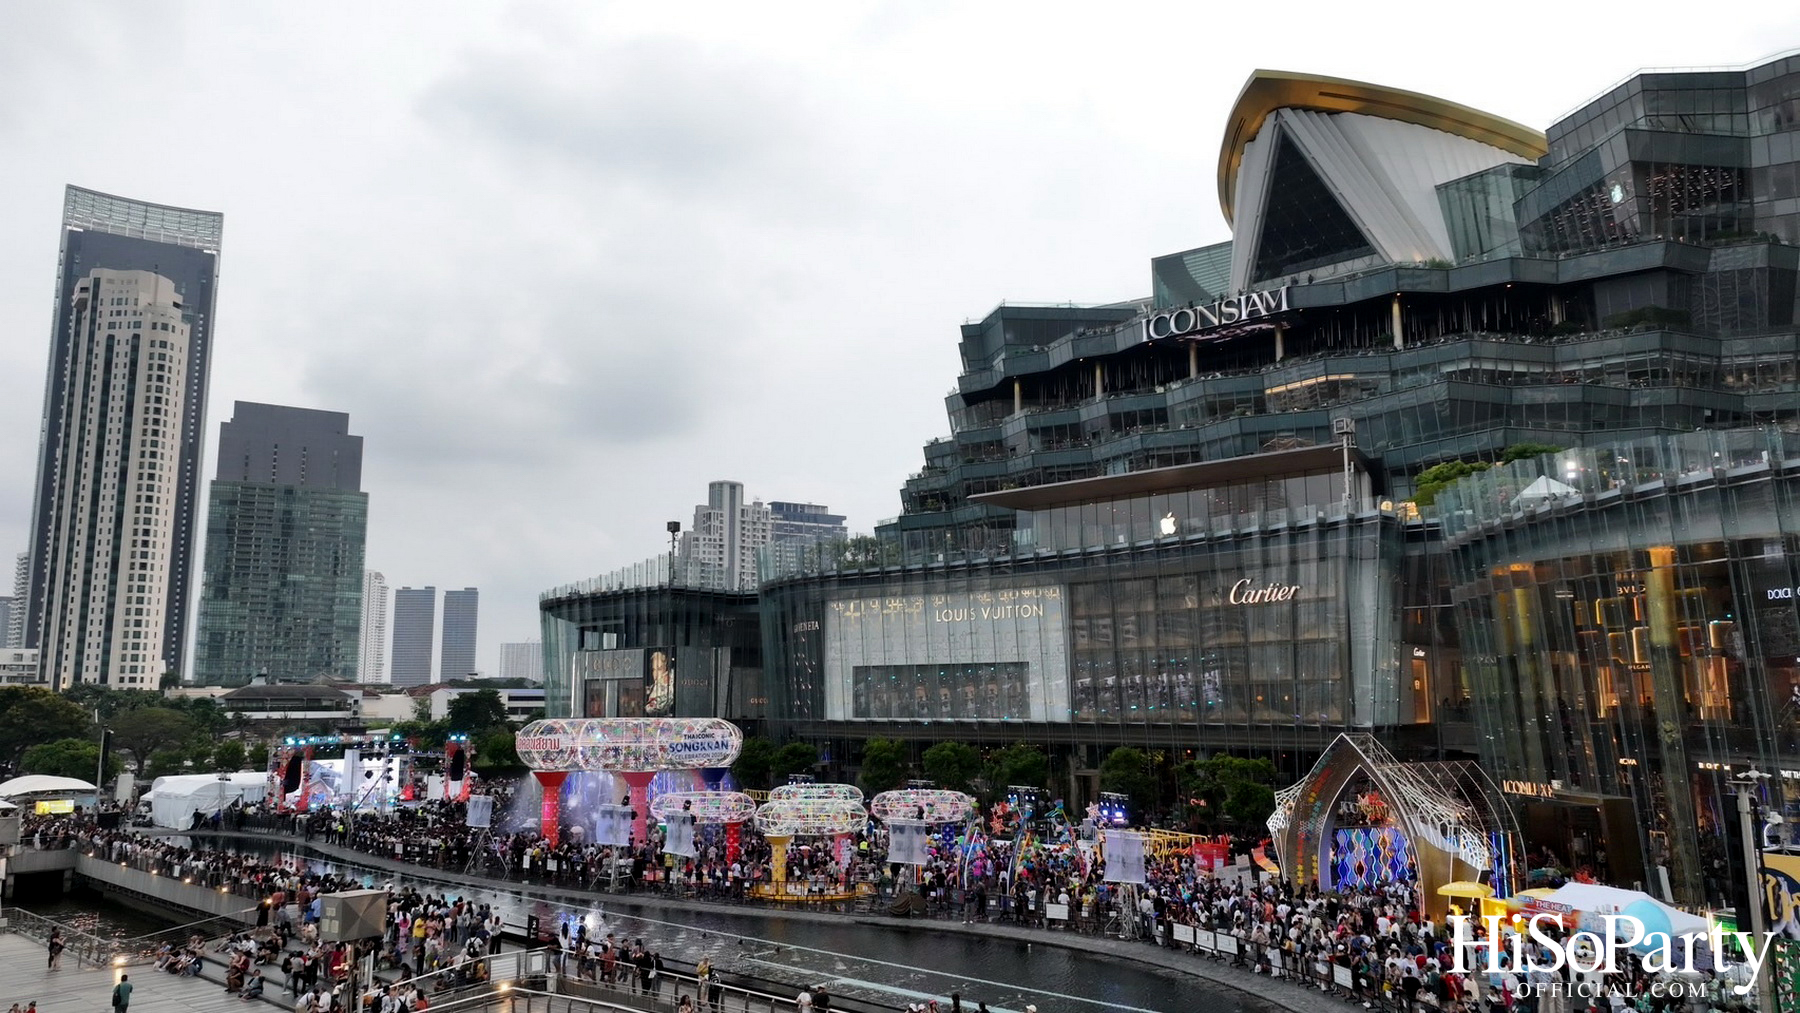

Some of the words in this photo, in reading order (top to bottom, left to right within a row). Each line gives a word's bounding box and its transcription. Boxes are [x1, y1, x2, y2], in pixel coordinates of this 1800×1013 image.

[1141, 285, 1290, 343] ICONSIAM
[1229, 578, 1301, 605] Cartier
[935, 608, 976, 623] LOUIS
[981, 604, 1045, 620] VUITTON
[669, 740, 729, 753] SONGKRAN
